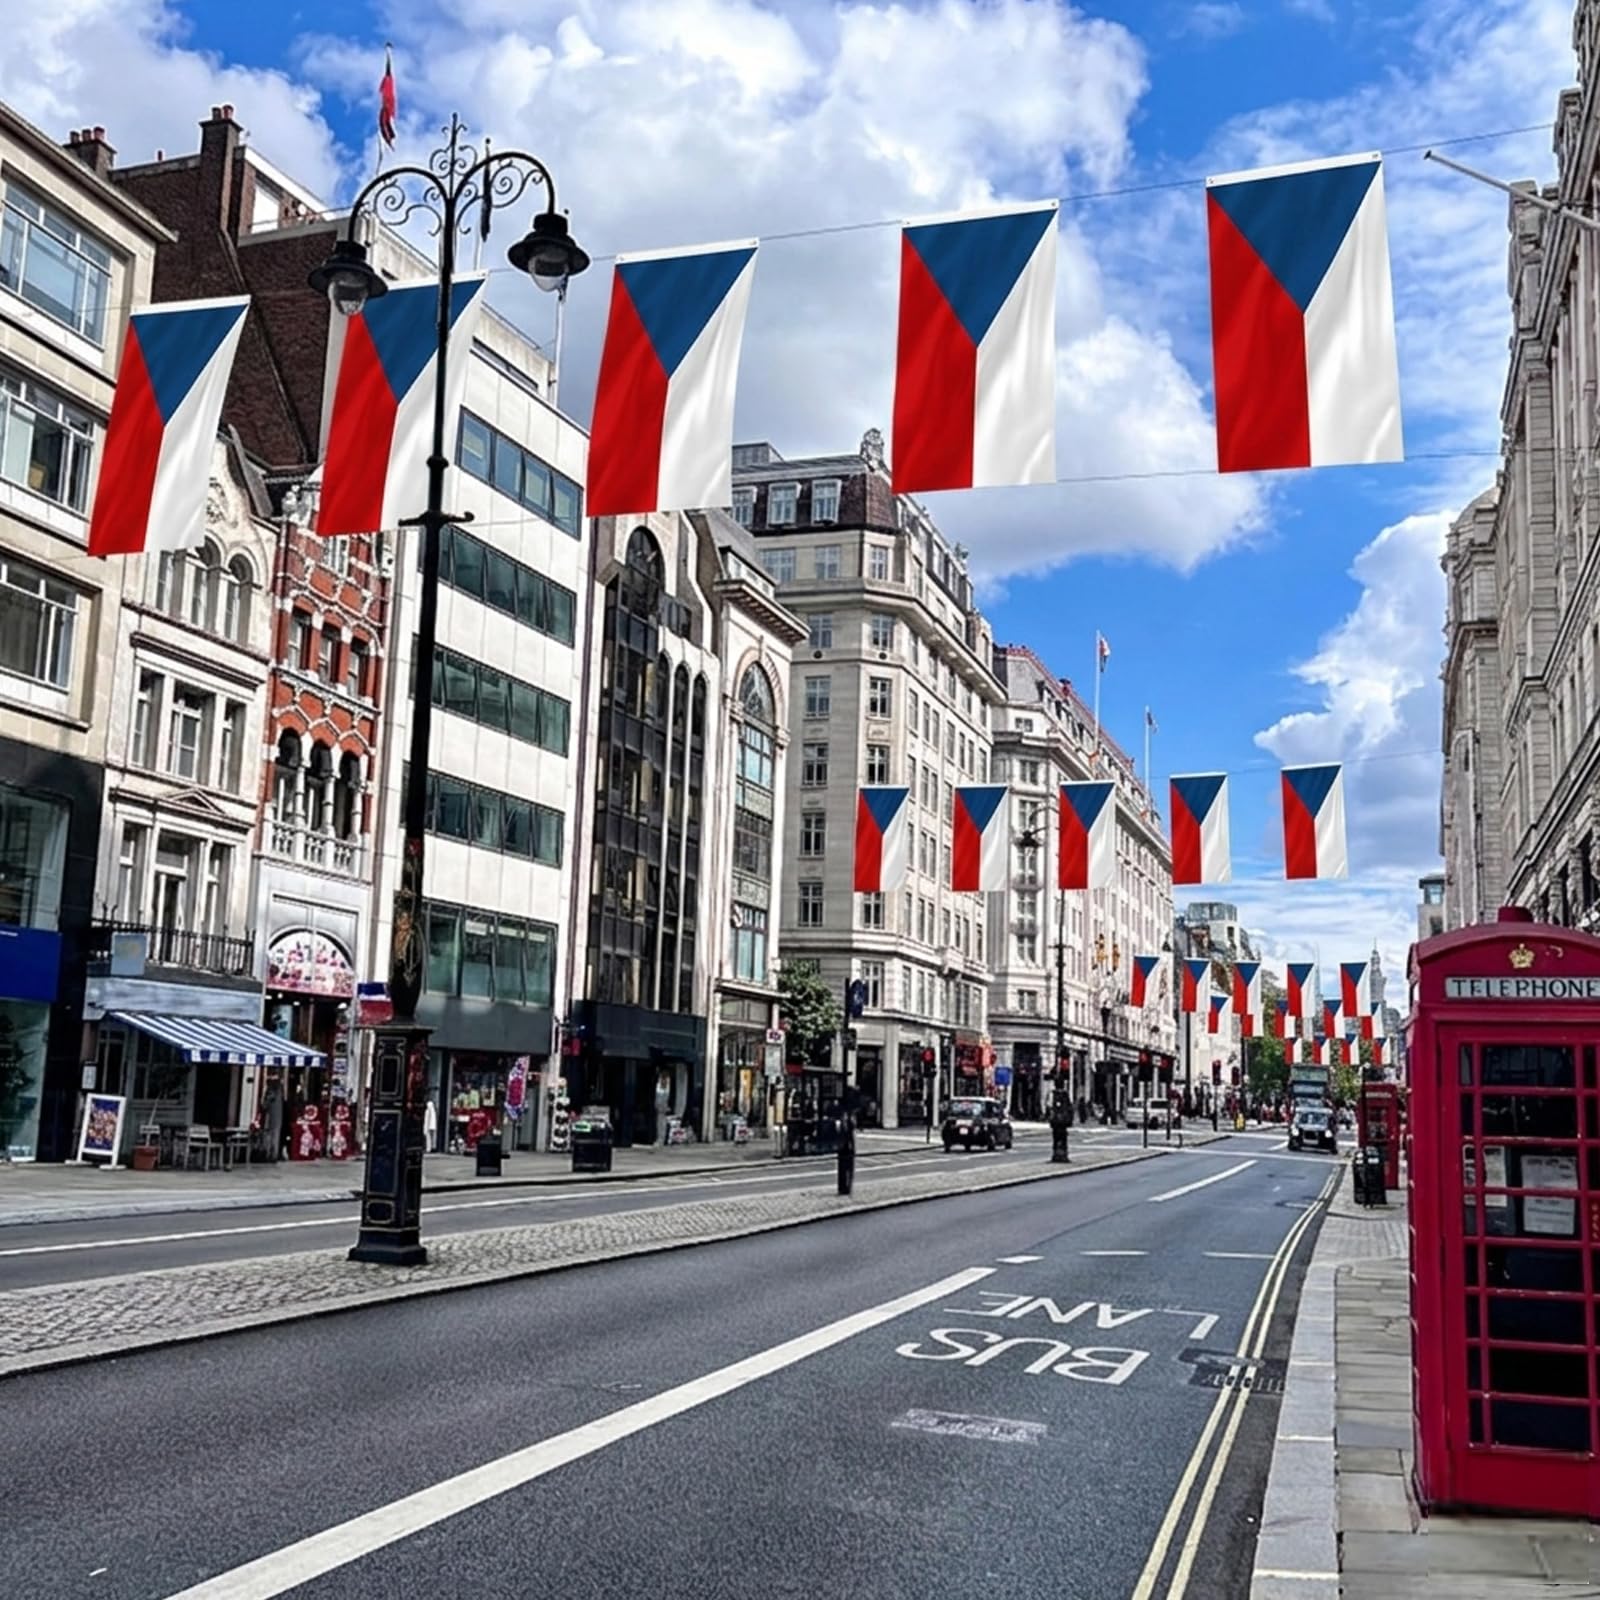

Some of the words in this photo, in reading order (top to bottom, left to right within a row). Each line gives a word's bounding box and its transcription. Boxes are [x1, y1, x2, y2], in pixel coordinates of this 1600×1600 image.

[1452, 979, 1600, 997] TELEPHONE
[943, 1291, 1219, 1339] LANE
[895, 1328, 1150, 1385] BUS
